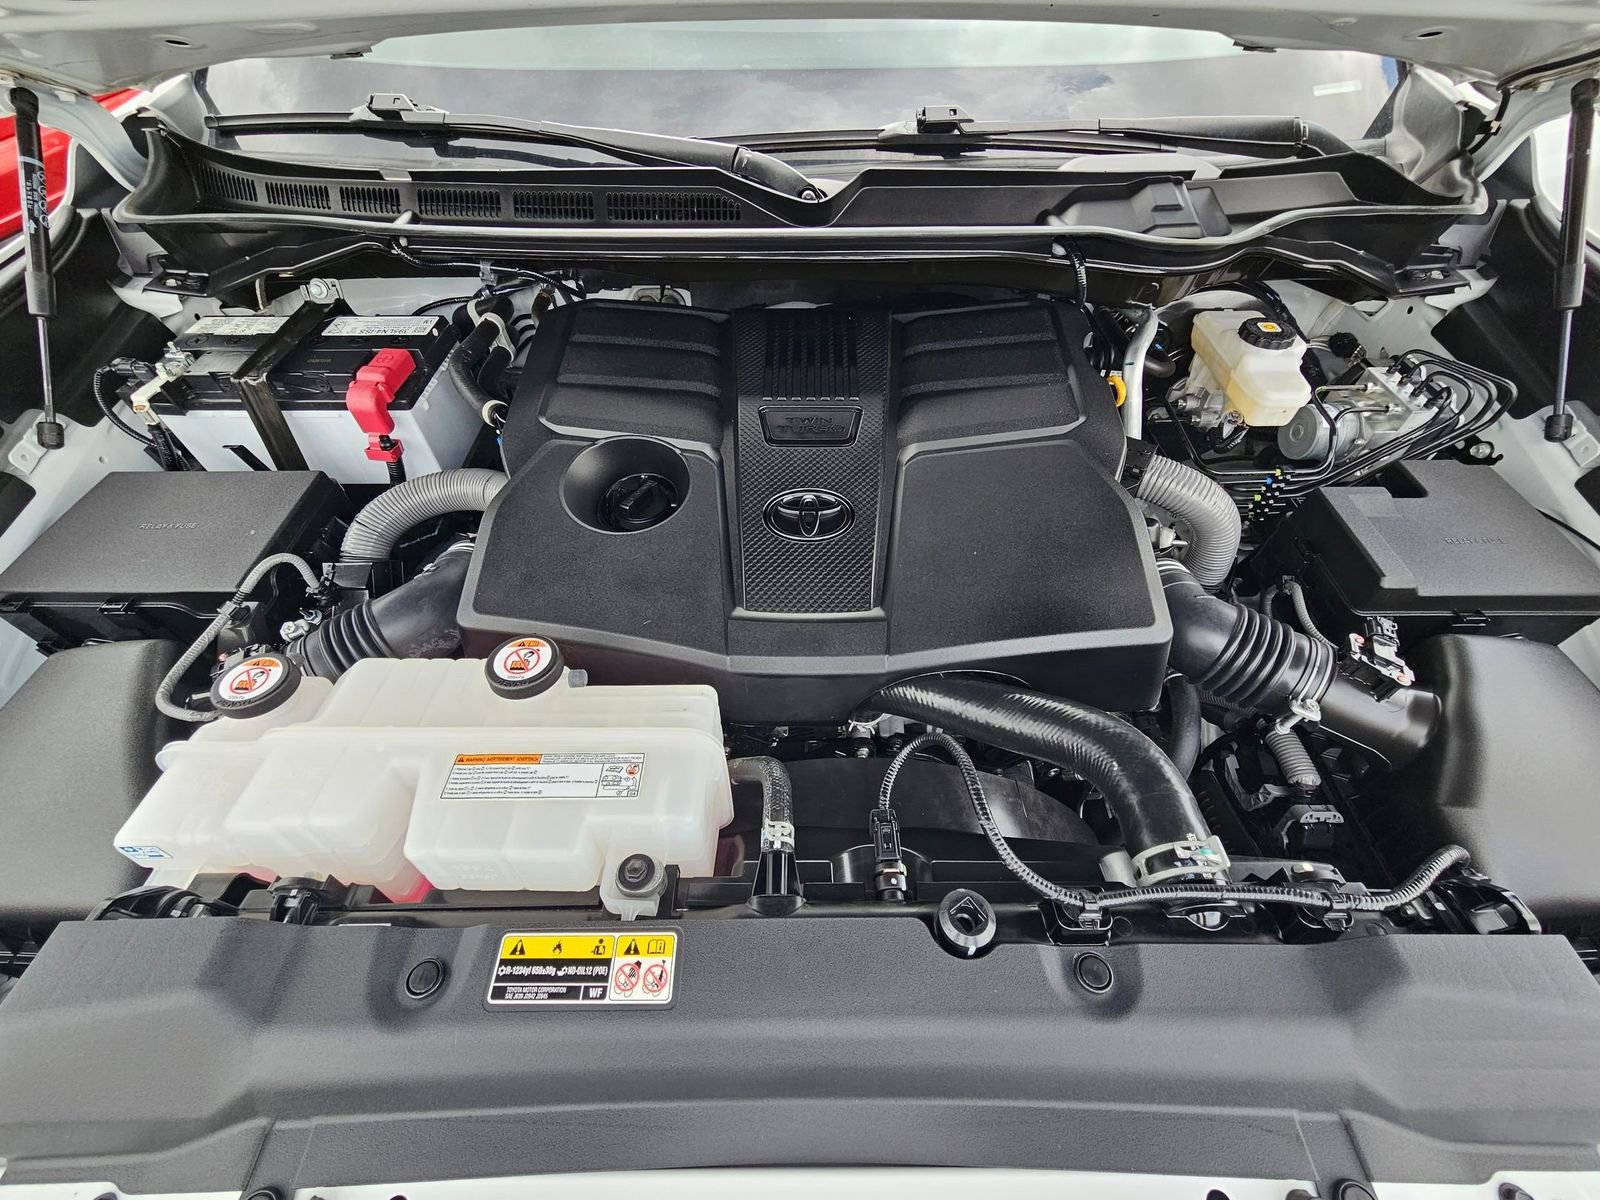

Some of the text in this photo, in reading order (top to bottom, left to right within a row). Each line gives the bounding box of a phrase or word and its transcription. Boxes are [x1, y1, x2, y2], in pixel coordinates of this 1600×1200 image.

[784, 416, 833, 425] TWIN
[505, 966, 531, 976] R-1234yf
[532, 966, 556, 976] 650±30g
[593, 966, 608, 976] (POE)
[589, 987, 604, 998] WF
